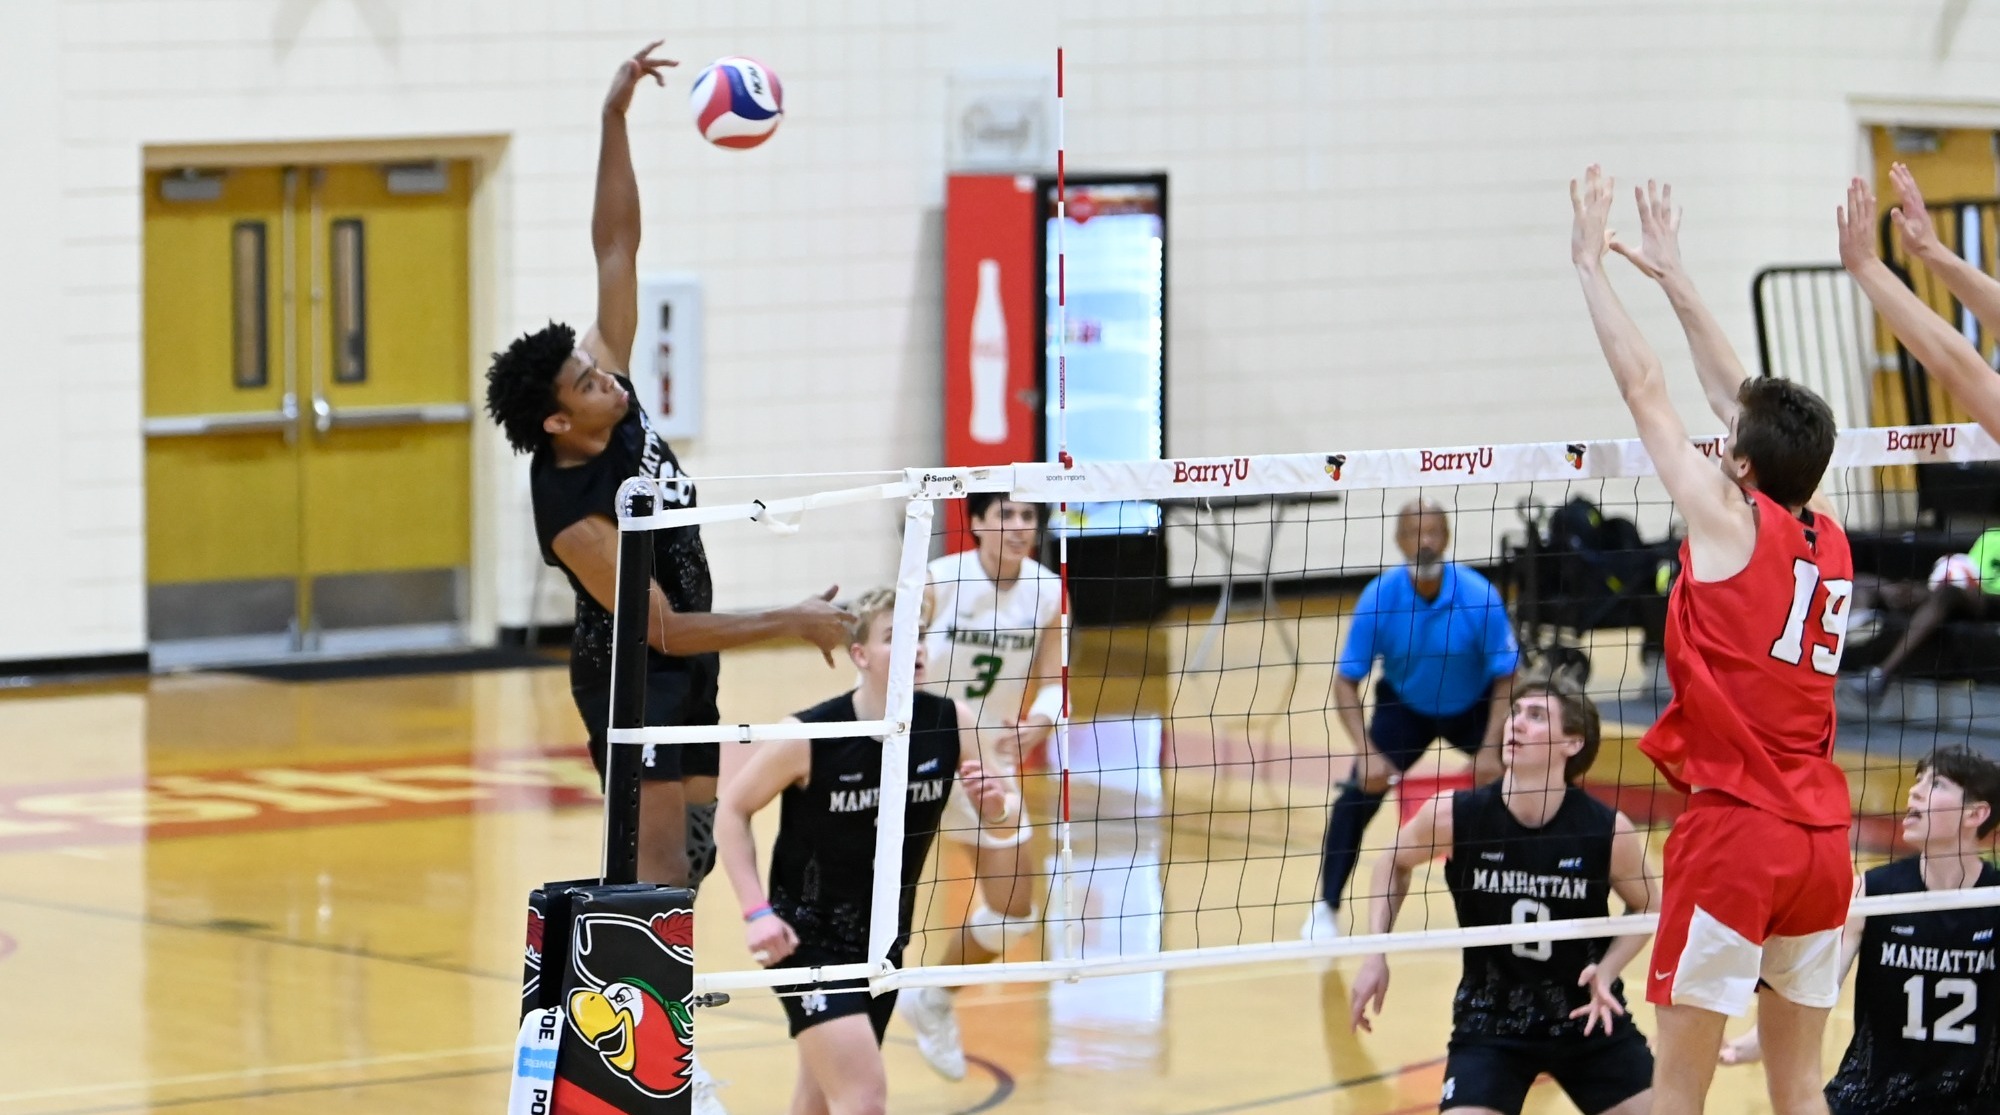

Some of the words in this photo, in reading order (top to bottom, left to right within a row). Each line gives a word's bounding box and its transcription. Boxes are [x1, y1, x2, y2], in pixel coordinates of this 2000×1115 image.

[1884, 427, 1956, 455] BarryU
[1173, 458, 1250, 487] BarryU
[1420, 447, 1493, 475] BarryU
[1768, 556, 1853, 677] 19
[965, 653, 1004, 699] 3
[829, 777, 944, 813] MANTAN
[1472, 867, 1588, 900] MANHATTAN
[1902, 974, 1978, 1045] 12
